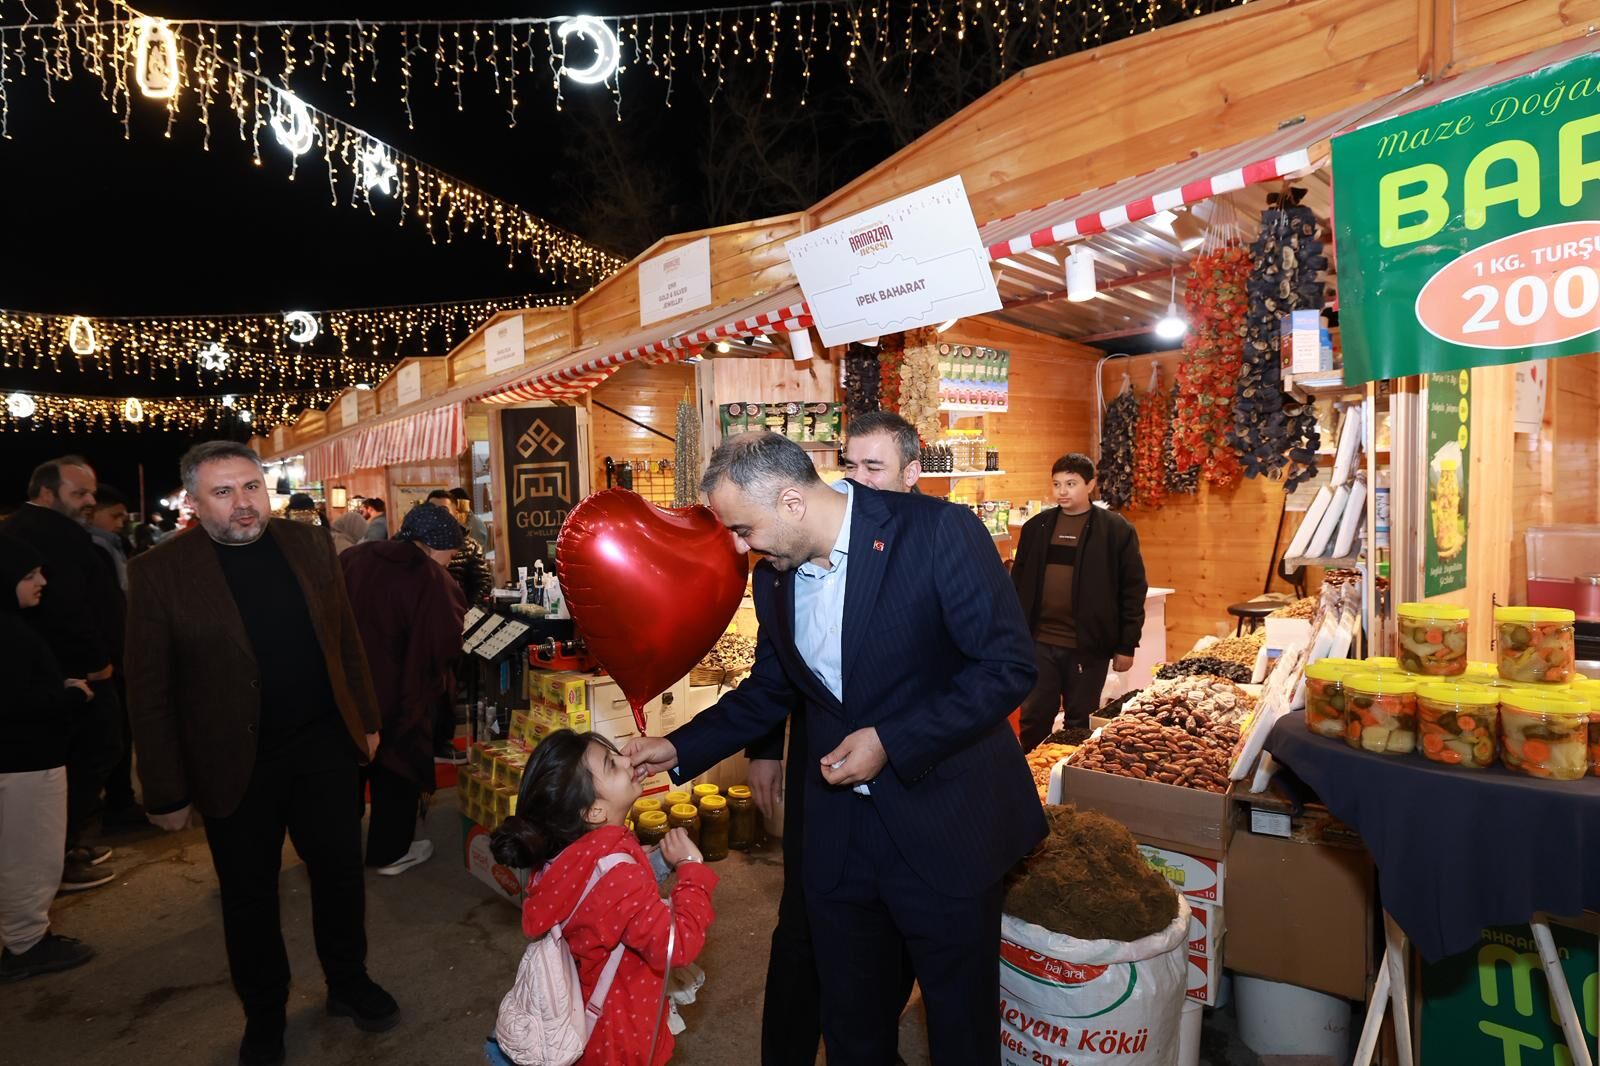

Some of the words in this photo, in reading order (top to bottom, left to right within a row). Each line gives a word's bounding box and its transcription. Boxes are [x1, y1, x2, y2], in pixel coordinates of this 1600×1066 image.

[1485, 77, 1600, 127] Doğa
[848, 224, 893, 253] RAMAZAN
[1473, 261, 1484, 277] 1
[1490, 254, 1526, 274] KG.
[879, 278, 926, 301] BAHARAT
[1461, 265, 1600, 334] 200
[1205, 891, 1215, 899] 10
[1194, 943, 1205, 951] 10
[1196, 991, 1206, 999] 10
[1078, 1028, 1149, 1055] Kökü
